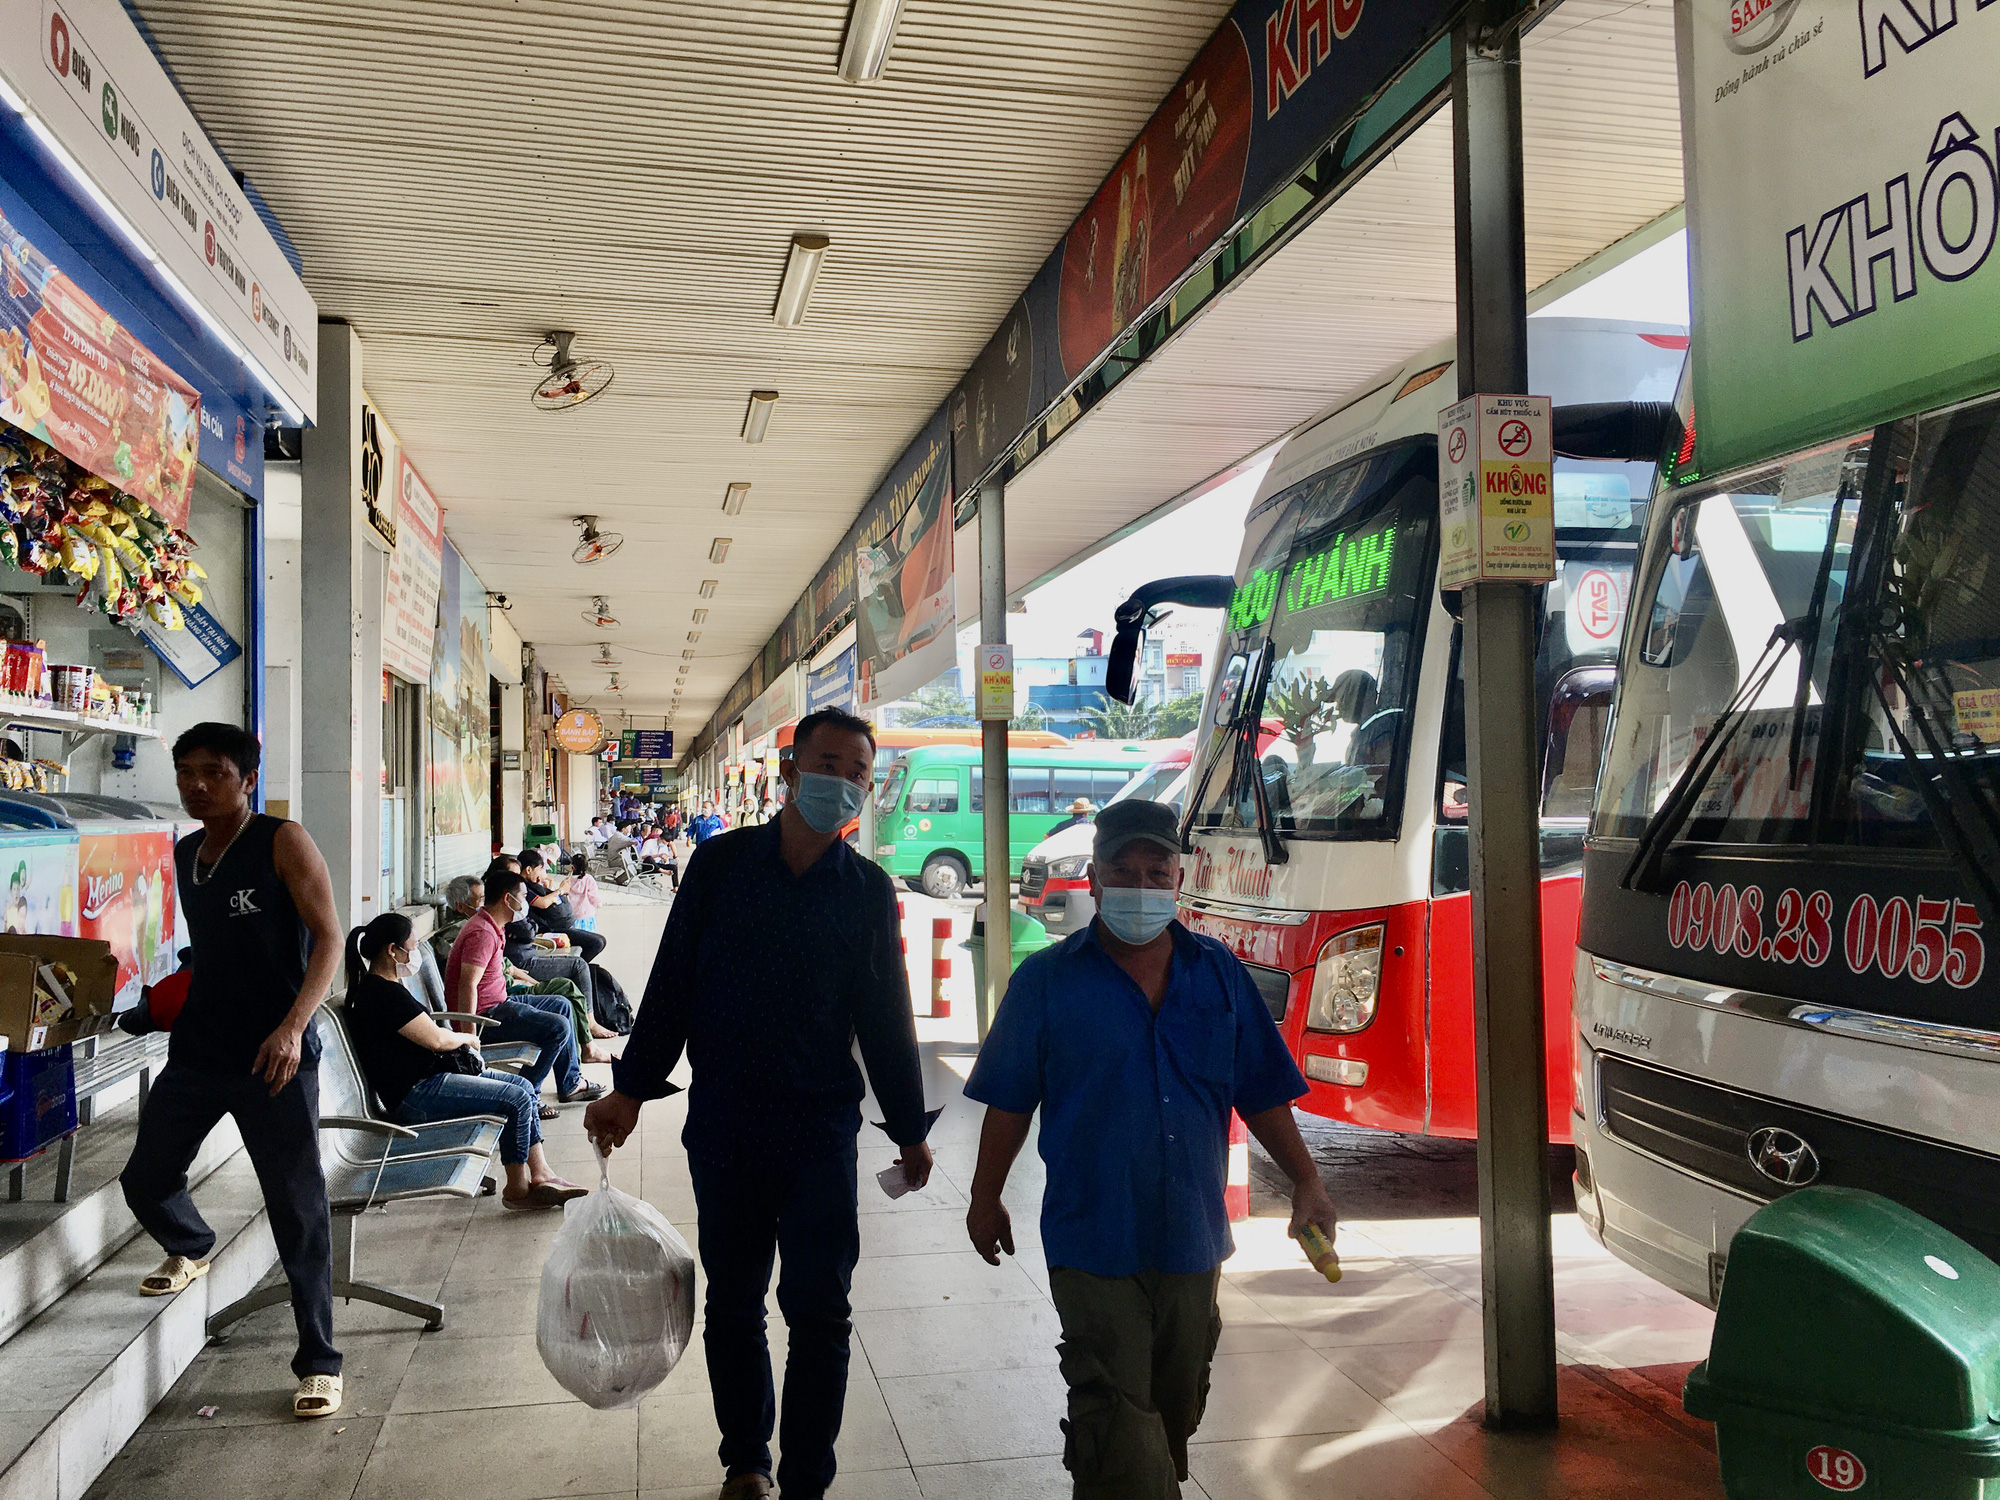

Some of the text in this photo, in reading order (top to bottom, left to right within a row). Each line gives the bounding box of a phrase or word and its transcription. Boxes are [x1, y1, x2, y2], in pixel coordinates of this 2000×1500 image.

[1742, 55, 1769, 83] hành
[1773, 45, 1786, 62] và
[1789, 29, 1811, 54] chia
[1786, 111, 2000, 344] KHÔ
[1498, 399, 1529, 407] KHU VỰC
[1486, 463, 1546, 497] KHÔNG
[1591, 581, 1608, 627] TAS
[193, 612, 209, 628] SẮM
[206, 625, 217, 638] TẠI
[214, 634, 231, 651] NHÀ
[1957, 693, 1978, 708] GIÁ
[625, 744, 631, 755] 2
[87, 868, 123, 908] Merino
[1668, 880, 1985, 990] 0908.28 0055
[1818, 1451, 1854, 1485] 19
